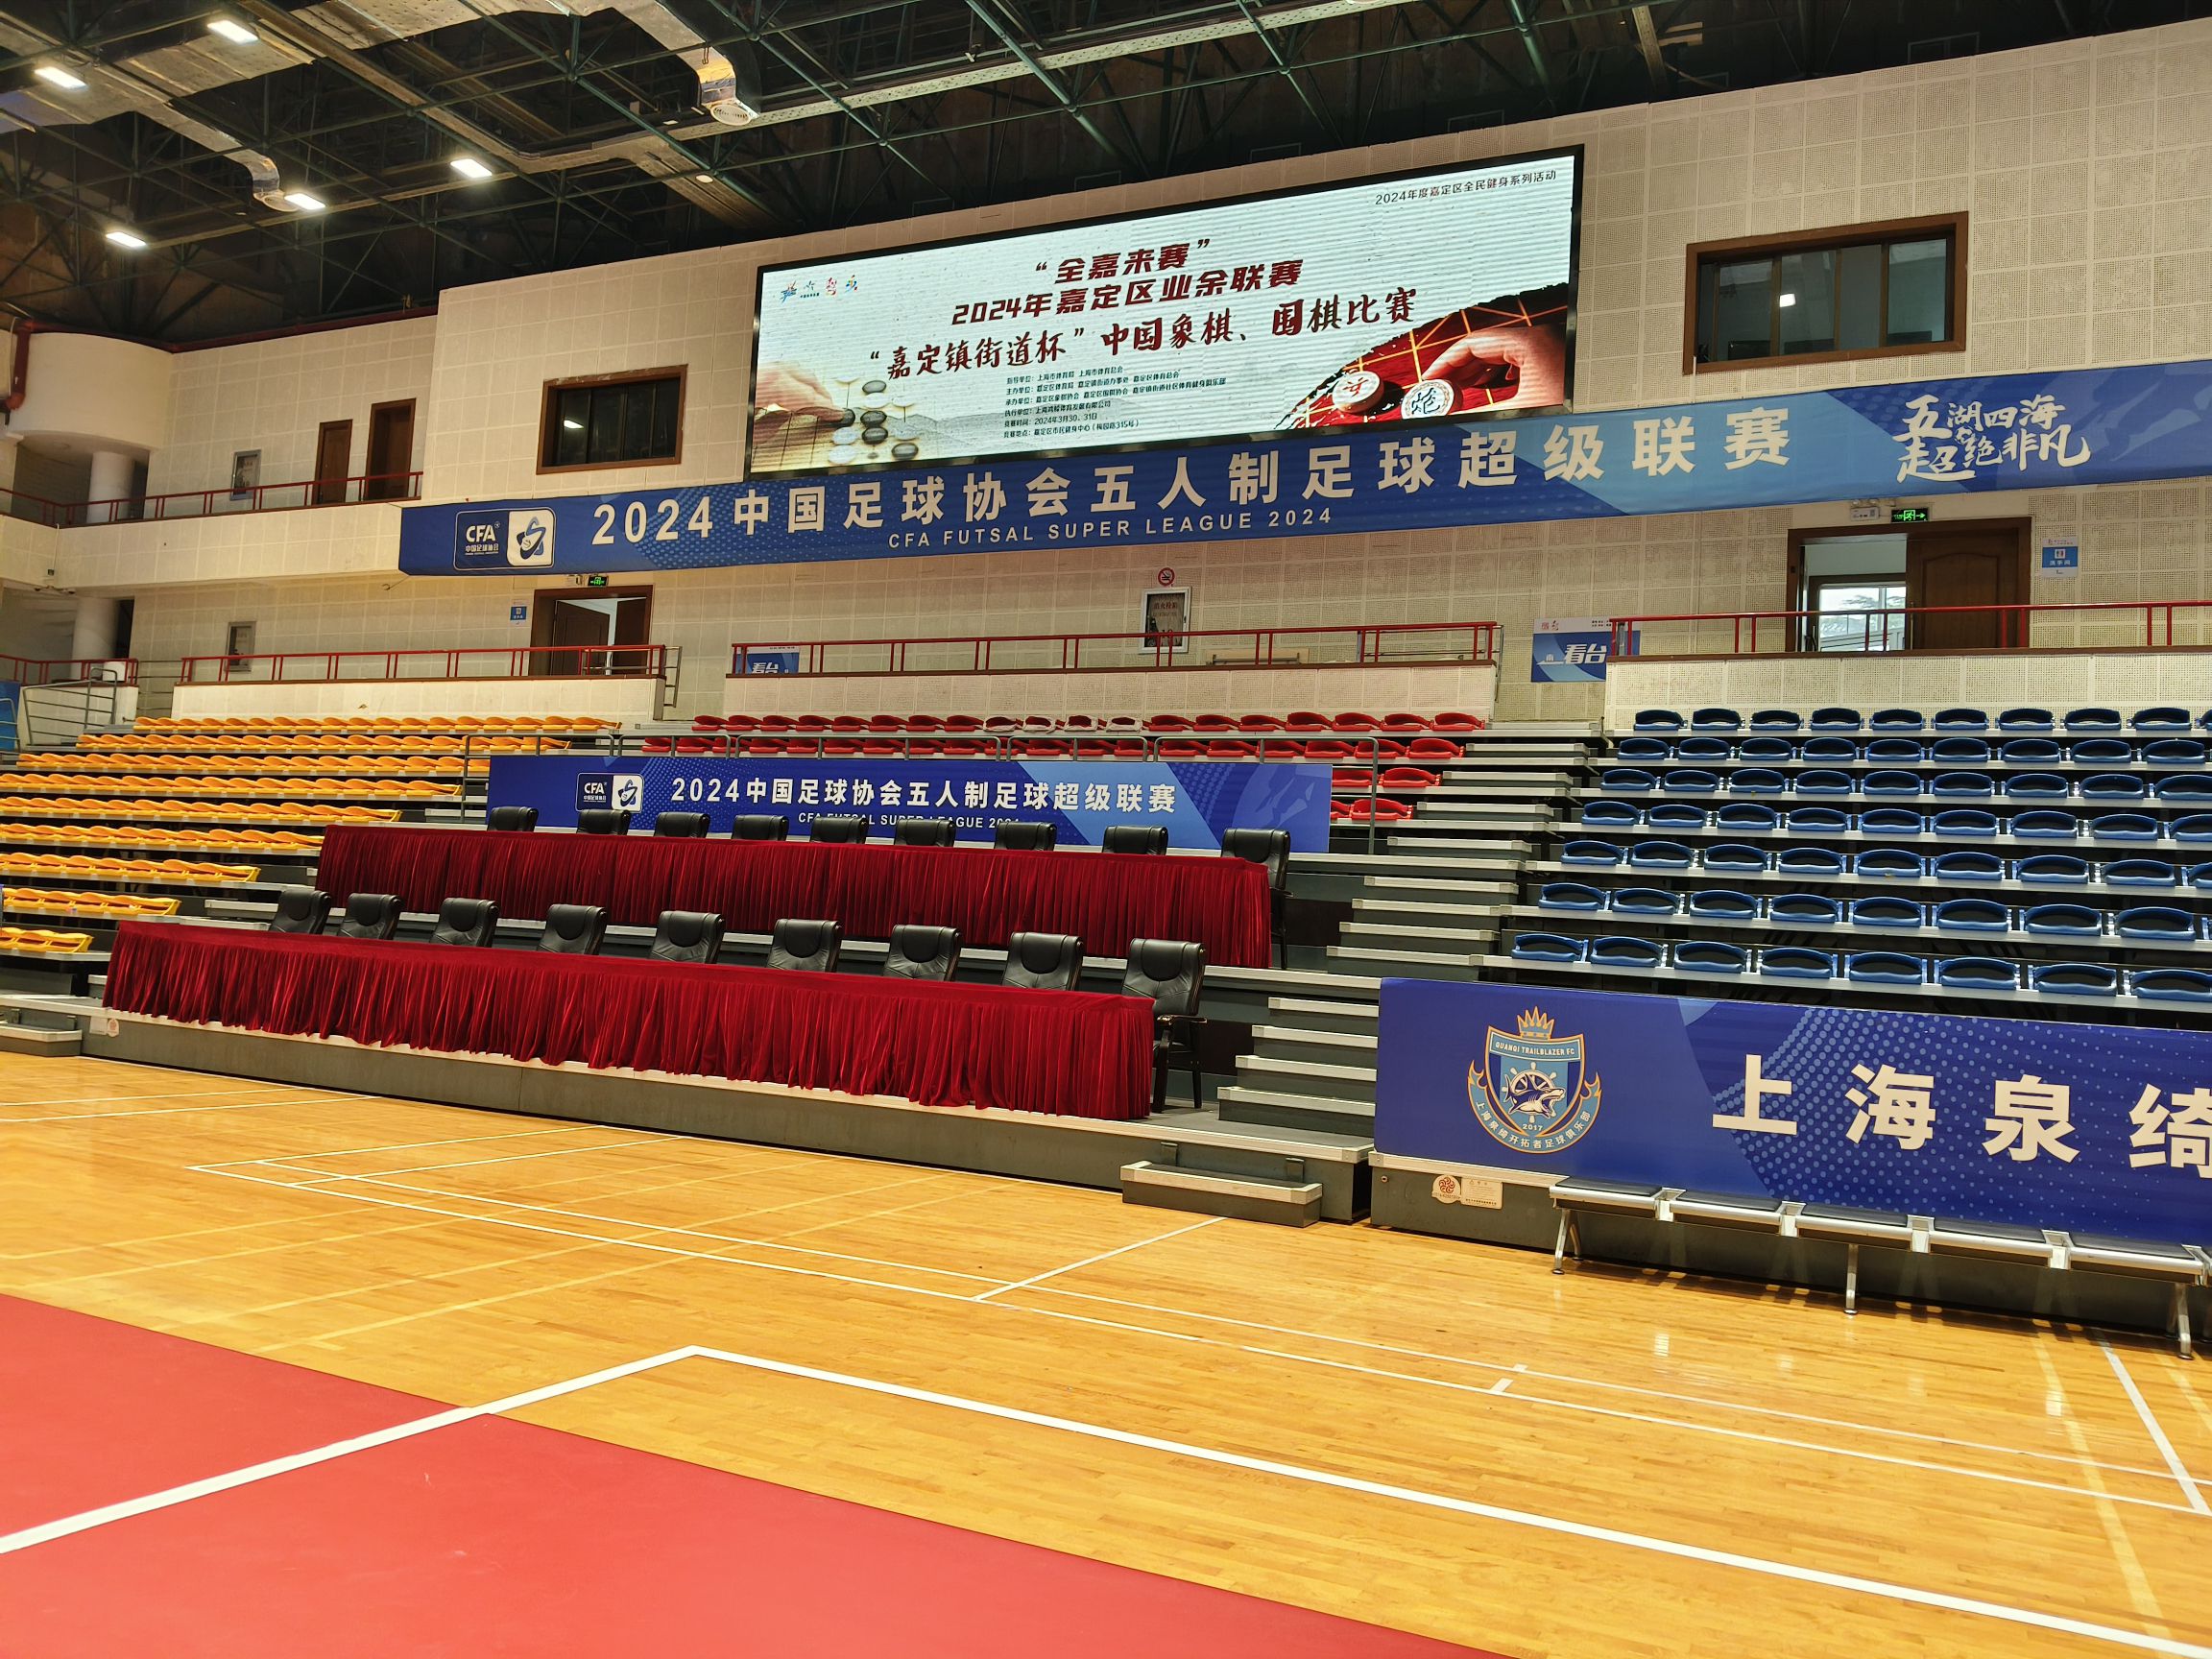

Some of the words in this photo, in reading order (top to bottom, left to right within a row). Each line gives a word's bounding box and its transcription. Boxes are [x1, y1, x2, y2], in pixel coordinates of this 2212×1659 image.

[1376, 170, 1556, 204] 2024年度嘉定区全民健身系列活动
[1035, 238, 1210, 285] “全嘉来赛”
[951, 259, 1304, 325] 2024年嘉定区业余联赛
[466, 524, 496, 542] CFA
[888, 532, 929, 548] CFA
[943, 526, 1034, 546] FUTSAL
[1047, 519, 1130, 540] SUPER
[1145, 512, 1252, 535] LEAGUE
[1267, 508, 1332, 527] 2024
[1564, 643, 1607, 664] 看台
[584, 782, 605, 794] CFA
[671, 776, 1177, 814] 2024中国足球协会五人制足球超级联赛
[1521, 1046, 1565, 1056] TRAILBLAZER
